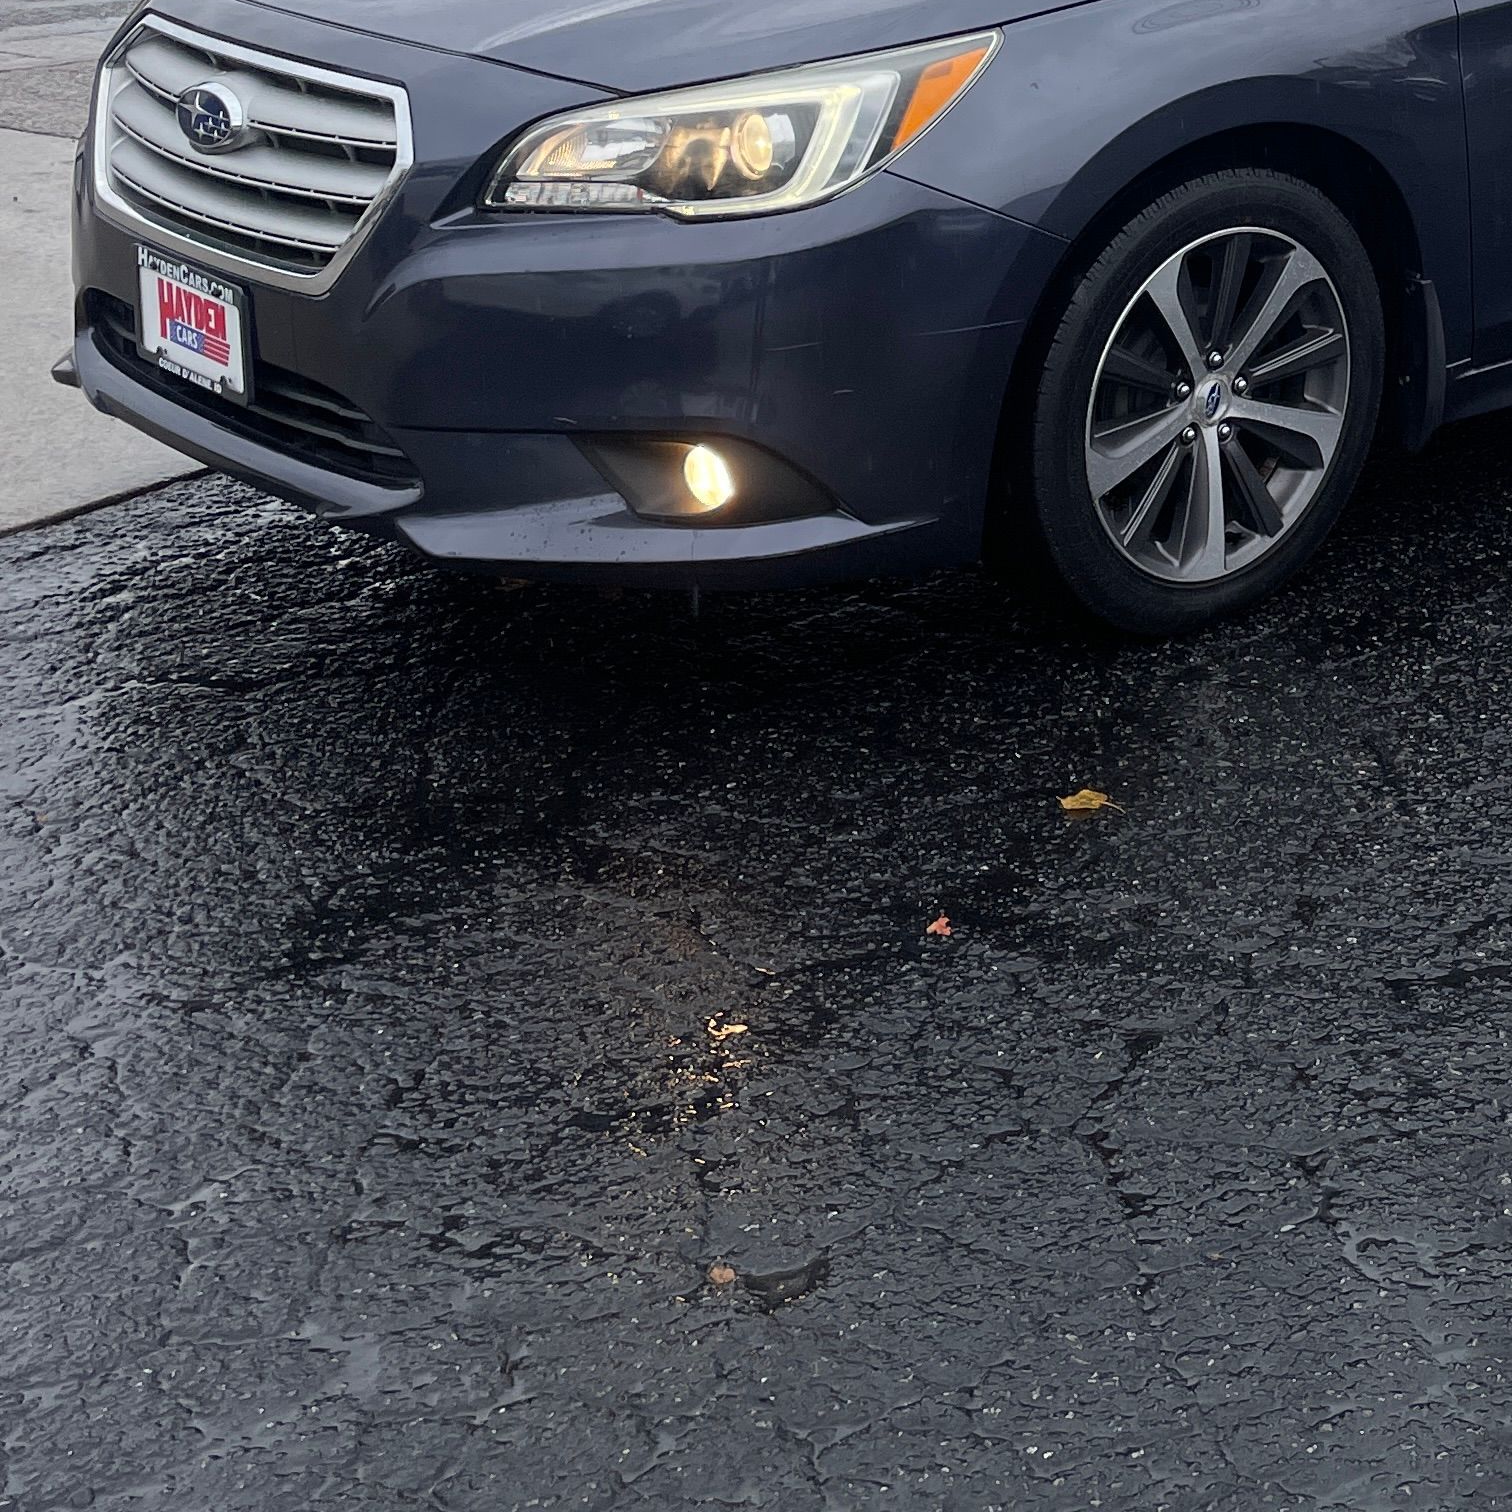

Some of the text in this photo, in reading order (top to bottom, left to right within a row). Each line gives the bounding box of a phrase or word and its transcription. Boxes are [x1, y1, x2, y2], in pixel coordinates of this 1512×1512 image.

[157, 277, 228, 341] HAYDEN
[176, 324, 199, 349] CARS
[158, 356, 183, 378] COEUR
